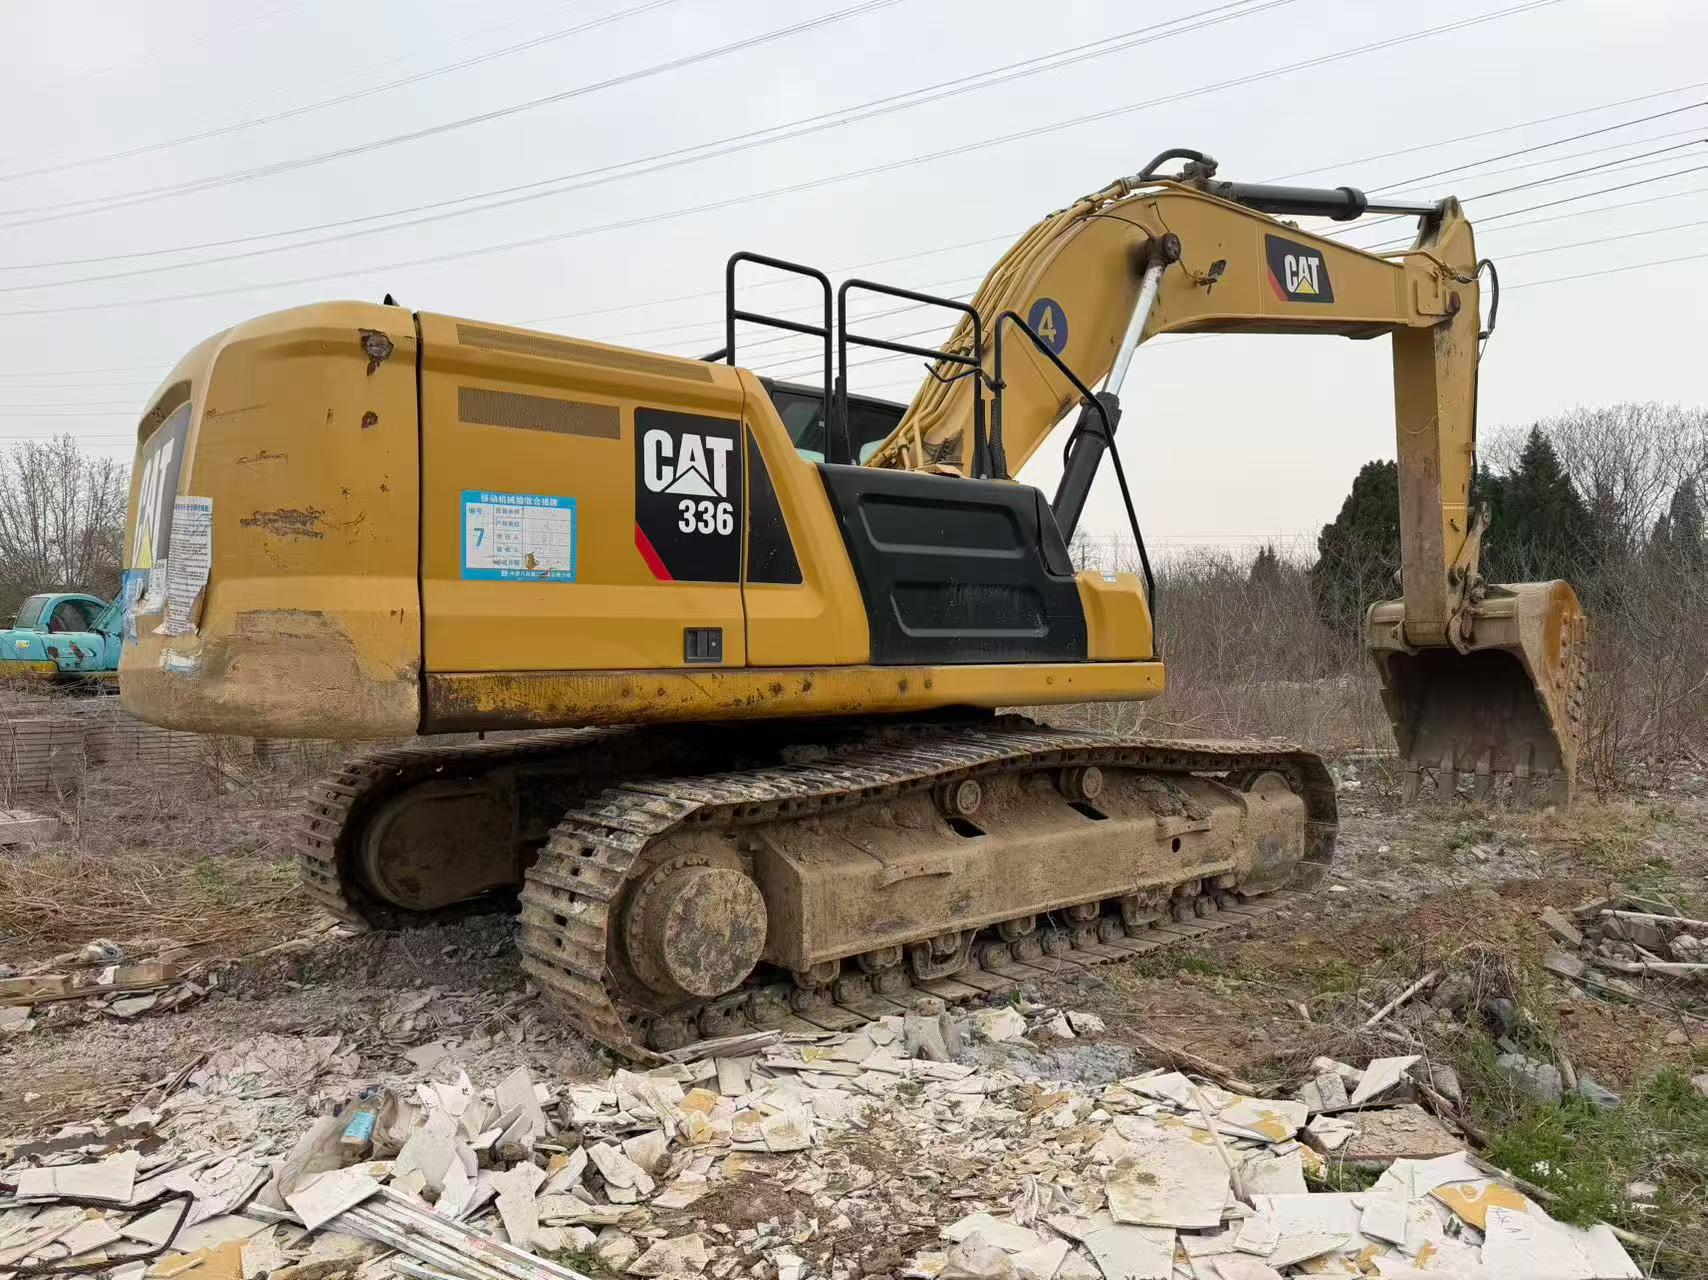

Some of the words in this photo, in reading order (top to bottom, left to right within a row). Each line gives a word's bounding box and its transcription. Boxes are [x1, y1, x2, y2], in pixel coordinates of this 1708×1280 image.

[1284, 254, 1320, 294] CAT
[1038, 305, 1057, 343] 4
[643, 429, 734, 498] CAT
[678, 499, 734, 536] 336
[473, 527, 485, 547] 7
